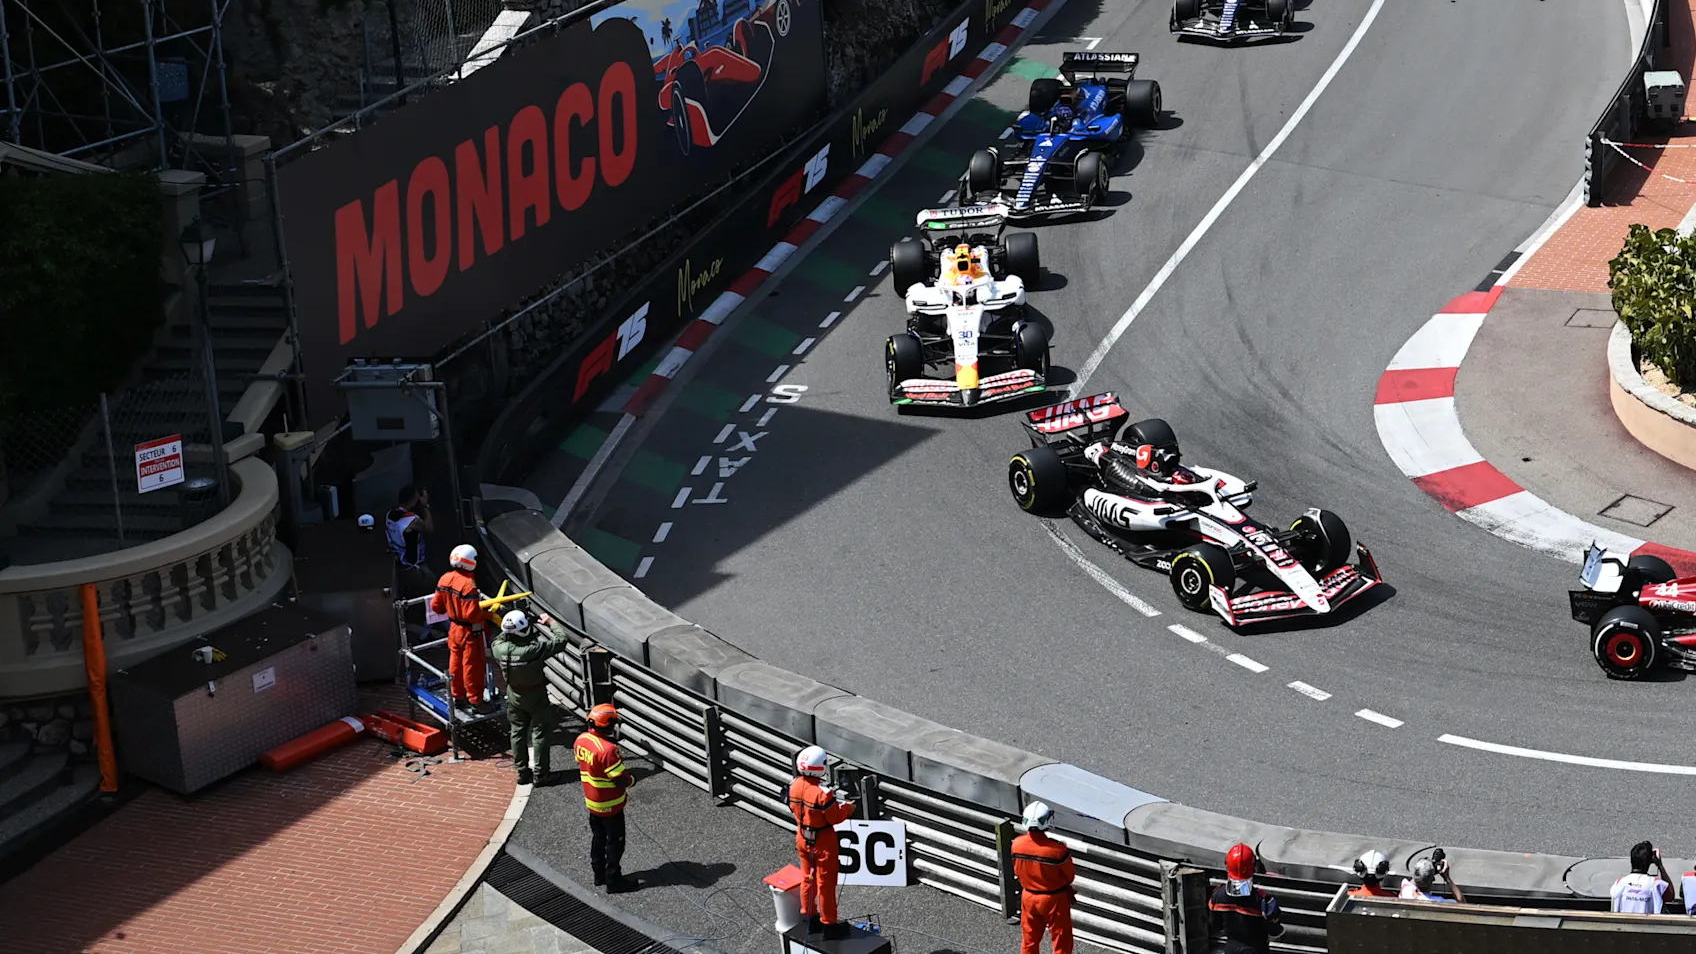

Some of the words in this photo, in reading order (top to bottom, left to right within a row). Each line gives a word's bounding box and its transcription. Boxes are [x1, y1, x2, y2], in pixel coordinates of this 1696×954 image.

[1074, 53, 1129, 61] ATLASSIAN
[852, 107, 888, 159] Monaco
[335, 61, 637, 345] MONACO
[942, 207, 984, 216] TUDOR
[678, 258, 723, 317] Monaco
[140, 448, 165, 461] SECTEUR
[172, 445, 177, 453] 6
[141, 458, 180, 476] INTERVENTION
[159, 474, 164, 482] 6
[1655, 582, 1679, 598] 44
[1659, 600, 1696, 612] UniCredit
[836, 830, 896, 876] SC
